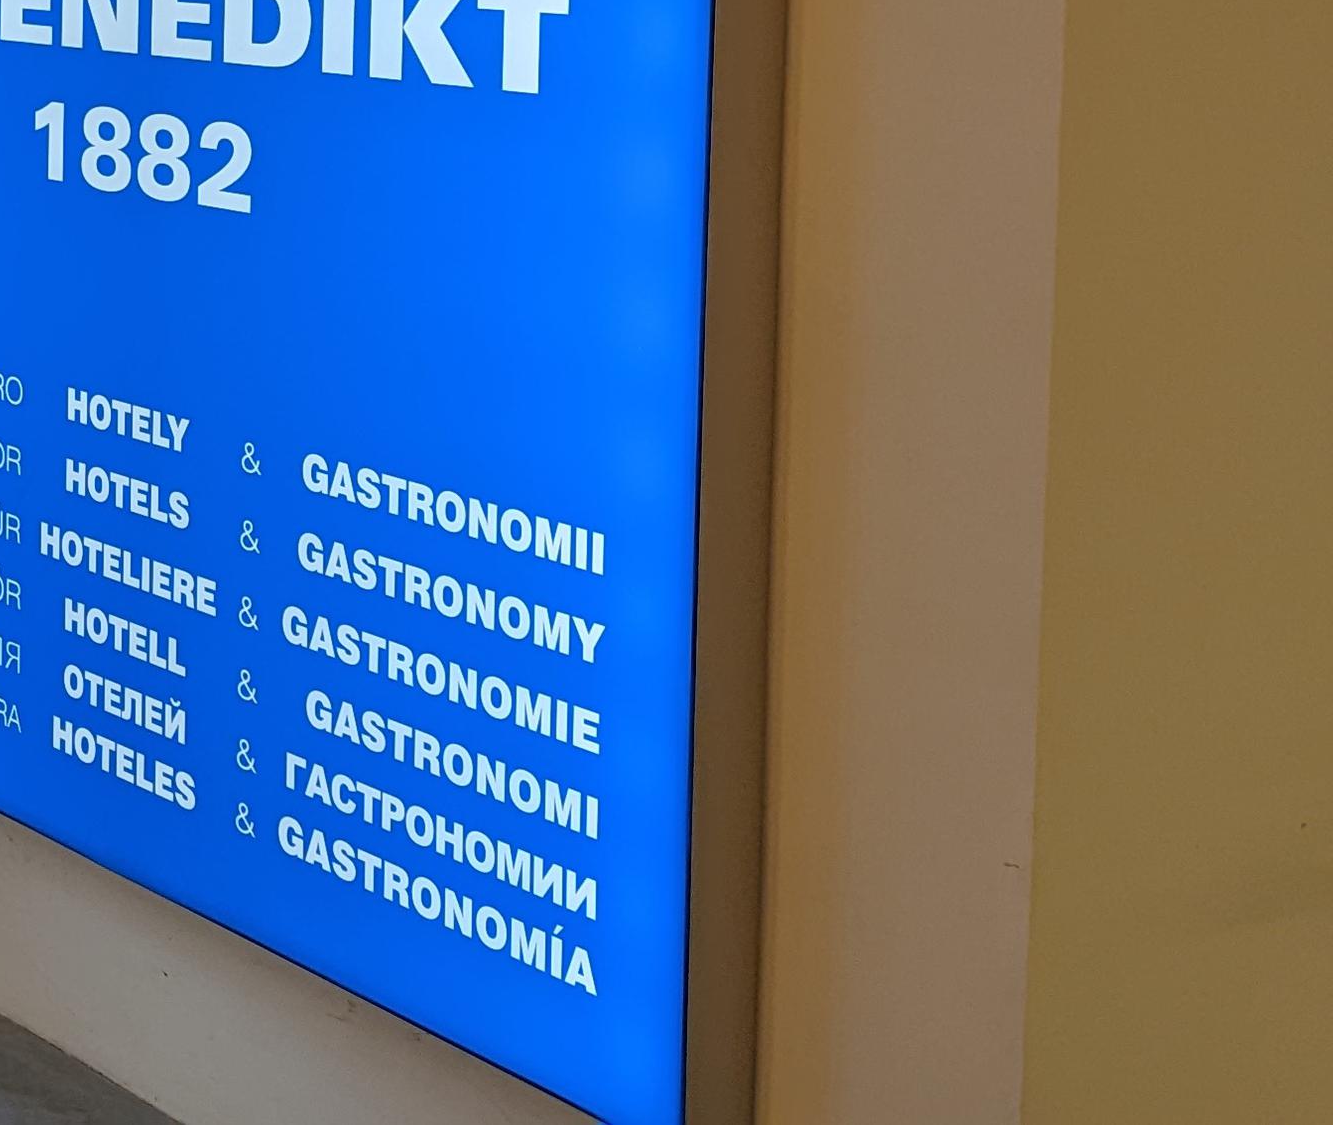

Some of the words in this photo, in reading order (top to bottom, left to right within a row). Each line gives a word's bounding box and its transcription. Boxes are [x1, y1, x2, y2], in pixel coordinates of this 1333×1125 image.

[35, 102, 251, 213] 1882
[66, 459, 189, 528] HOTELS
[241, 521, 259, 553] &
[298, 533, 605, 662] GASTRONOMY
[68, 388, 189, 451] HOTELY
[242, 443, 260, 474] &
[303, 454, 604, 574] GASTRONOMII
[41, 522, 216, 616] HOTELIERE
[239, 597, 257, 629] &
[283, 606, 599, 754] GASTRONOMIE
[65, 598, 185, 676] HOTELL
[238, 670, 256, 703] &
[307, 691, 598, 839] GASTRONOMI
[53, 716, 195, 809] HOTELES
[236, 803, 254, 837] &
[279, 817, 596, 995] GASTRONOMÍA
[64, 665, 185, 744] ОТЕЛЕЙ
[237, 739, 255, 772] &
[287, 753, 596, 920] ГАСТРОНОМИИ
